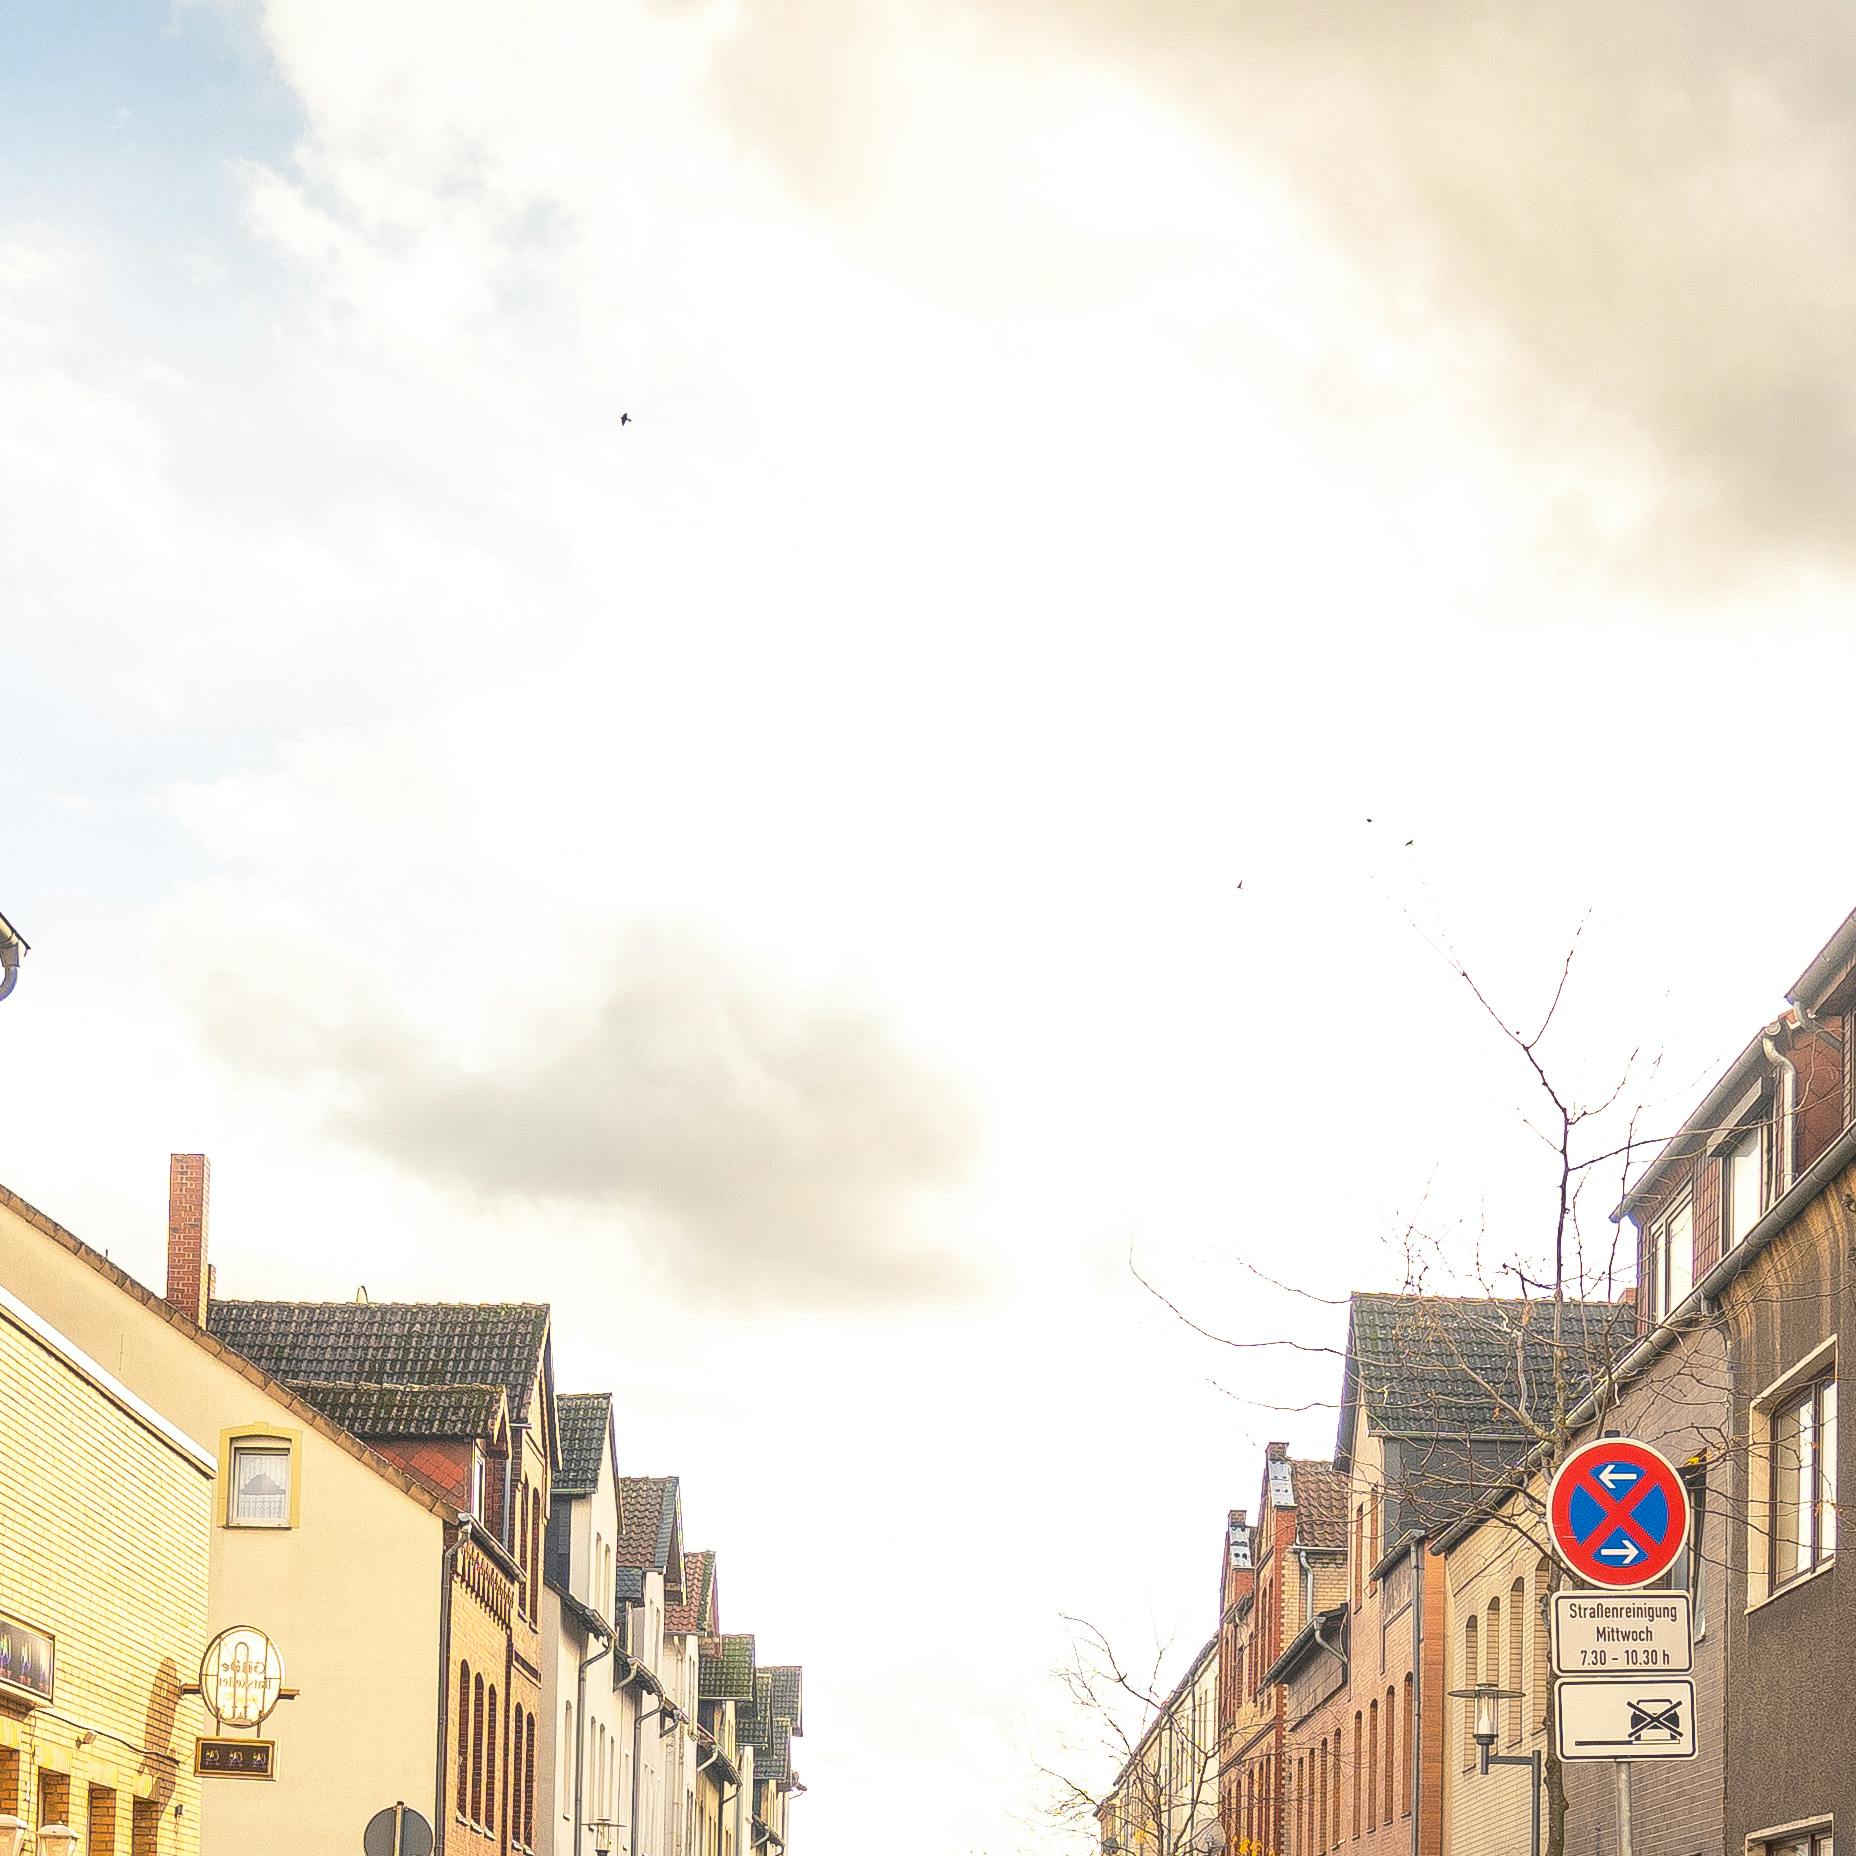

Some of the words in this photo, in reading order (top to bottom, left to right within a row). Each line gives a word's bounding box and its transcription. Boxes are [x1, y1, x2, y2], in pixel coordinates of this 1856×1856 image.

[1569, 1602, 1677, 1622] Straßenreinigung
[1596, 1626, 1653, 1642] Mittwoch
[1580, 1649, 1607, 1666] 7.30
[1624, 1649, 1658, 1665] 10.30
[1662, 1649, 1670, 1665] h
